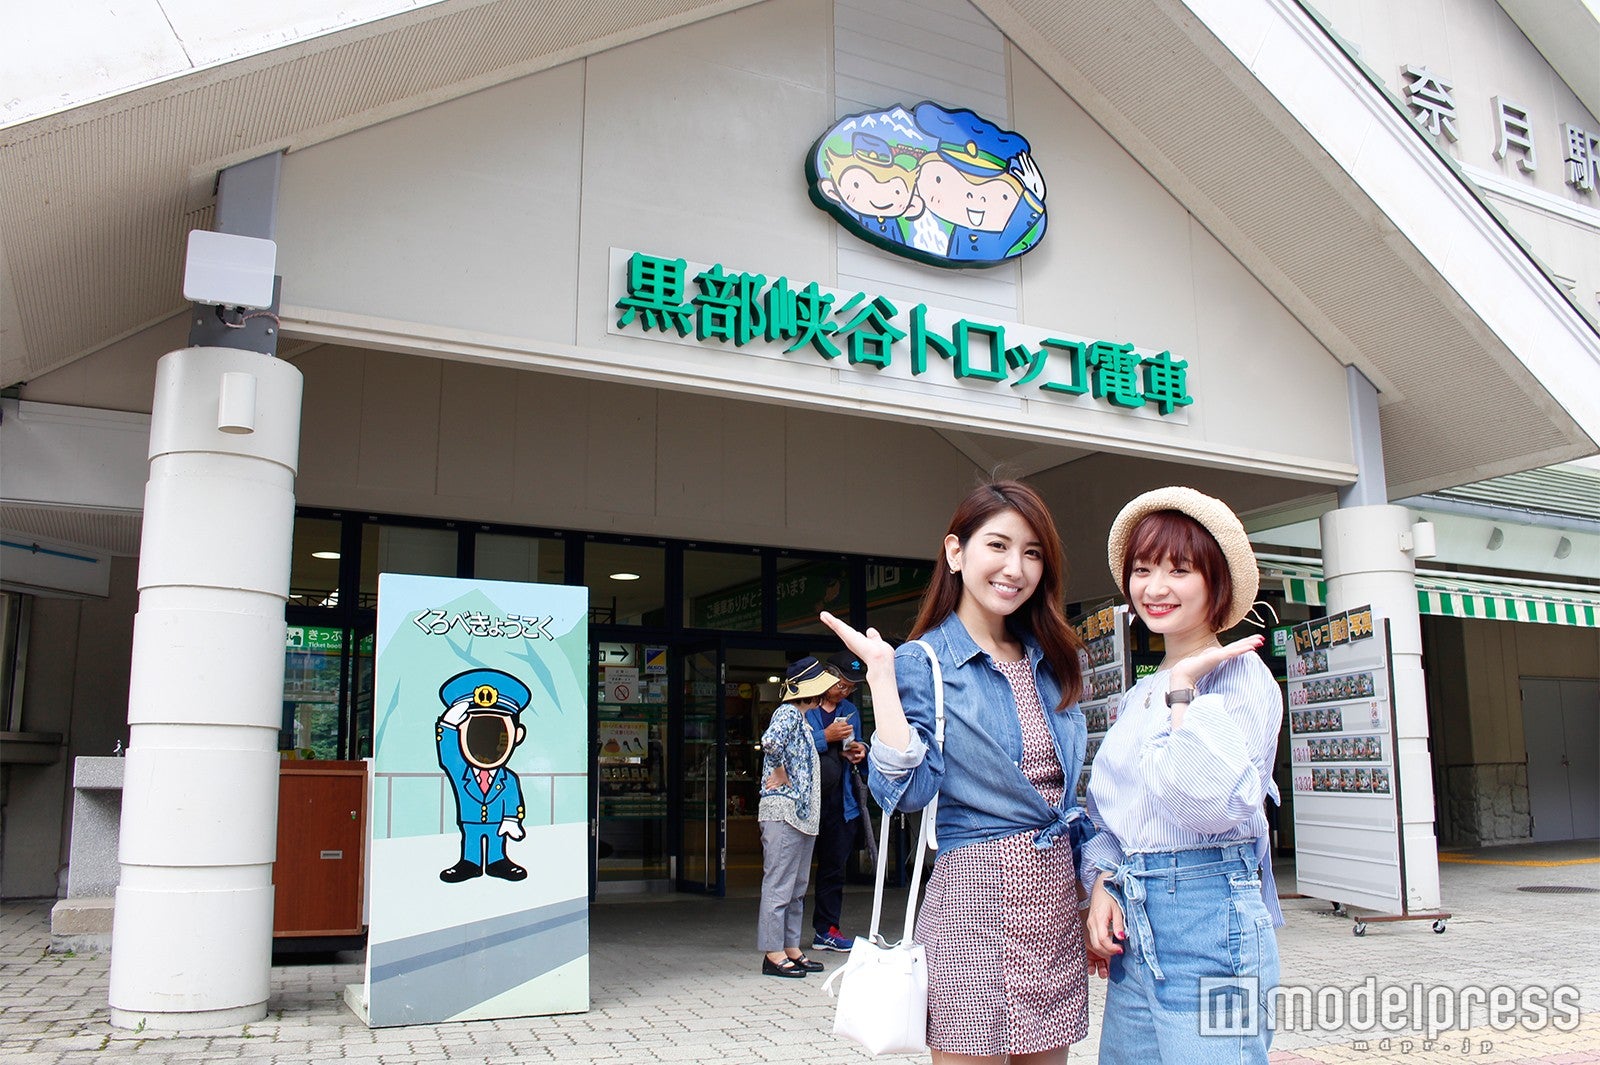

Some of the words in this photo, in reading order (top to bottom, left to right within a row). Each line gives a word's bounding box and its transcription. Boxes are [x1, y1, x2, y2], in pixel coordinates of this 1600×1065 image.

[614, 251, 1194, 416] 黒部峡谷トロッコ電車
[412, 608, 555, 641] くろべきょうこく
